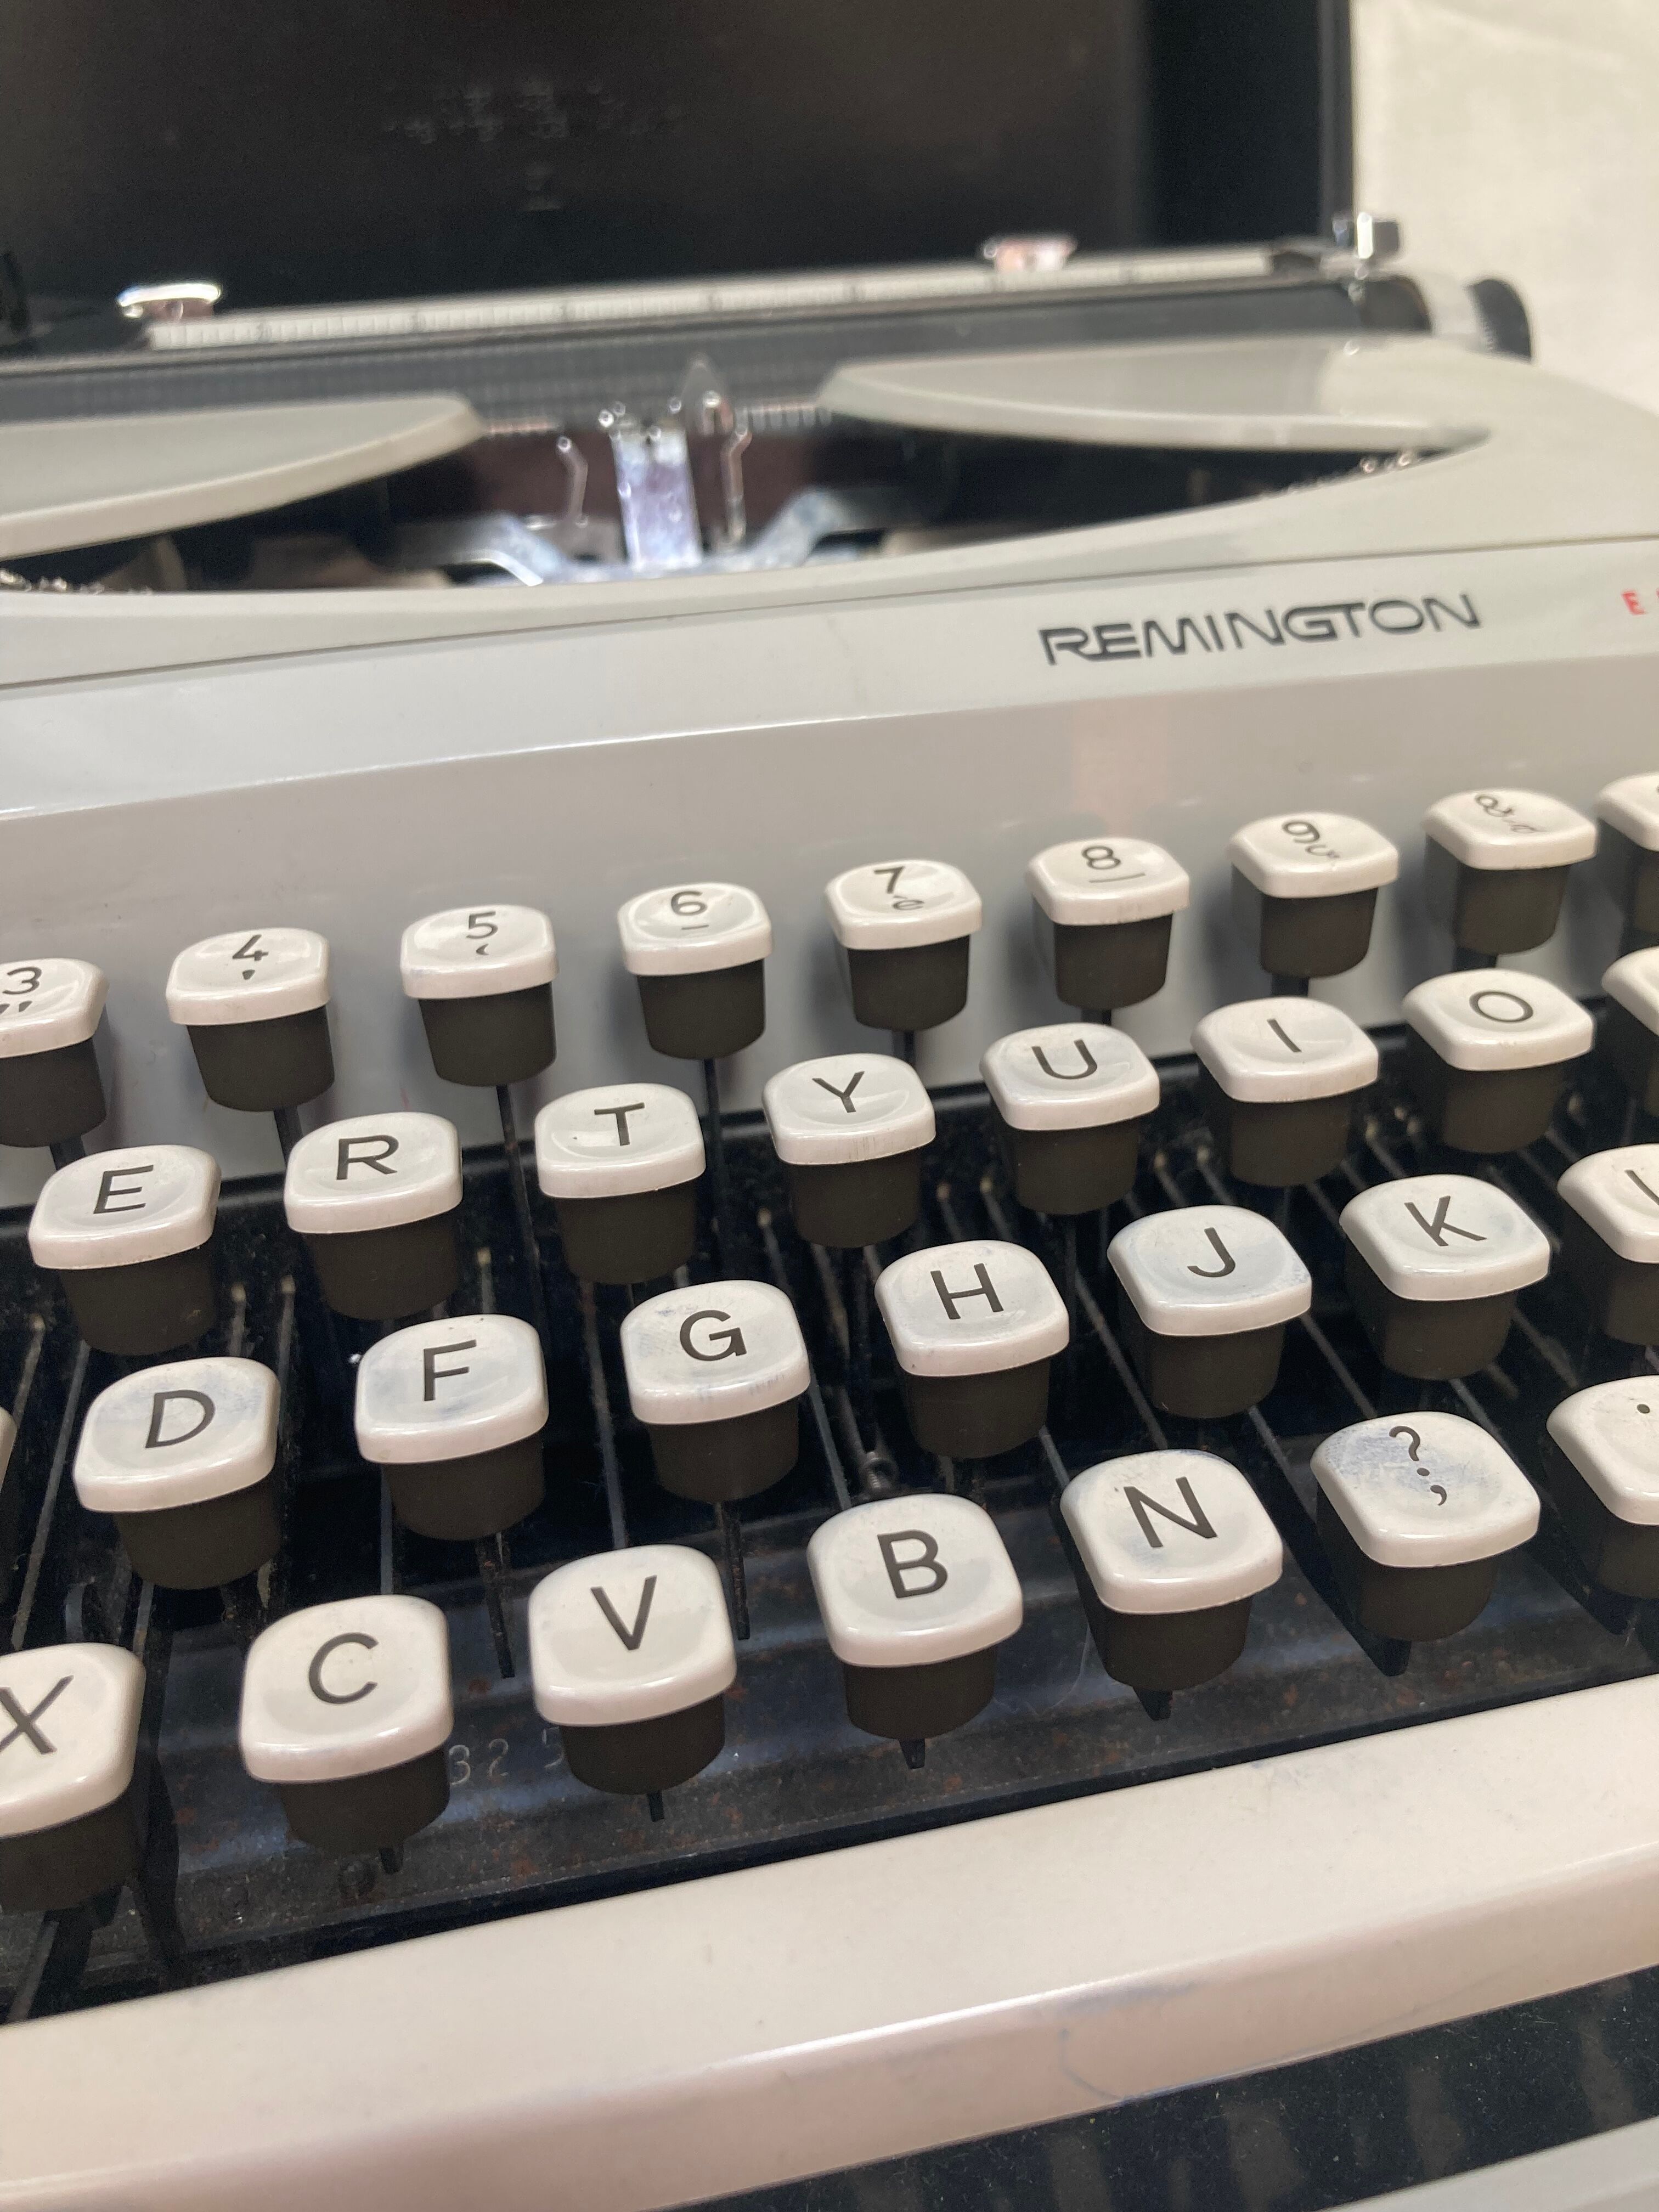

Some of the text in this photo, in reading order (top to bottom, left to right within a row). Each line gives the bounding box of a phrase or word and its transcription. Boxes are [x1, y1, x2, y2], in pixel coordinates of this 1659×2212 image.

[1039, 594, 1481, 665] REMINGTON
[1282, 821, 1320, 843] 9
[874, 866, 905, 894] 7
[1081, 845, 1121, 870] 8
[466, 911, 498, 939] 5
[671, 891, 707, 916] 6
[232, 934, 269, 961] 4
[2, 967, 42, 995] 3
[1470, 991, 1533, 1023] O
[1032, 1040, 1097, 1080] U
[812, 1071, 864, 1113] Y
[594, 1103, 645, 1146] T
[336, 1135, 398, 1180] R
[93, 1165, 153, 1214] E
[1404, 1196, 1487, 1246] K
[1188, 1228, 1235, 1278] J
[930, 1263, 1004, 1320] H
[680, 1310, 747, 1361] G
[424, 1340, 476, 1401] F
[145, 1390, 215, 1448] D
[1389, 1426, 1430, 1476] ?
[1124, 1477, 1217, 1548] N
[877, 1531, 947, 1599] B
[591, 1576, 657, 1651] V
[308, 1633, 378, 1705] C
[0, 1676, 72, 1754] X
